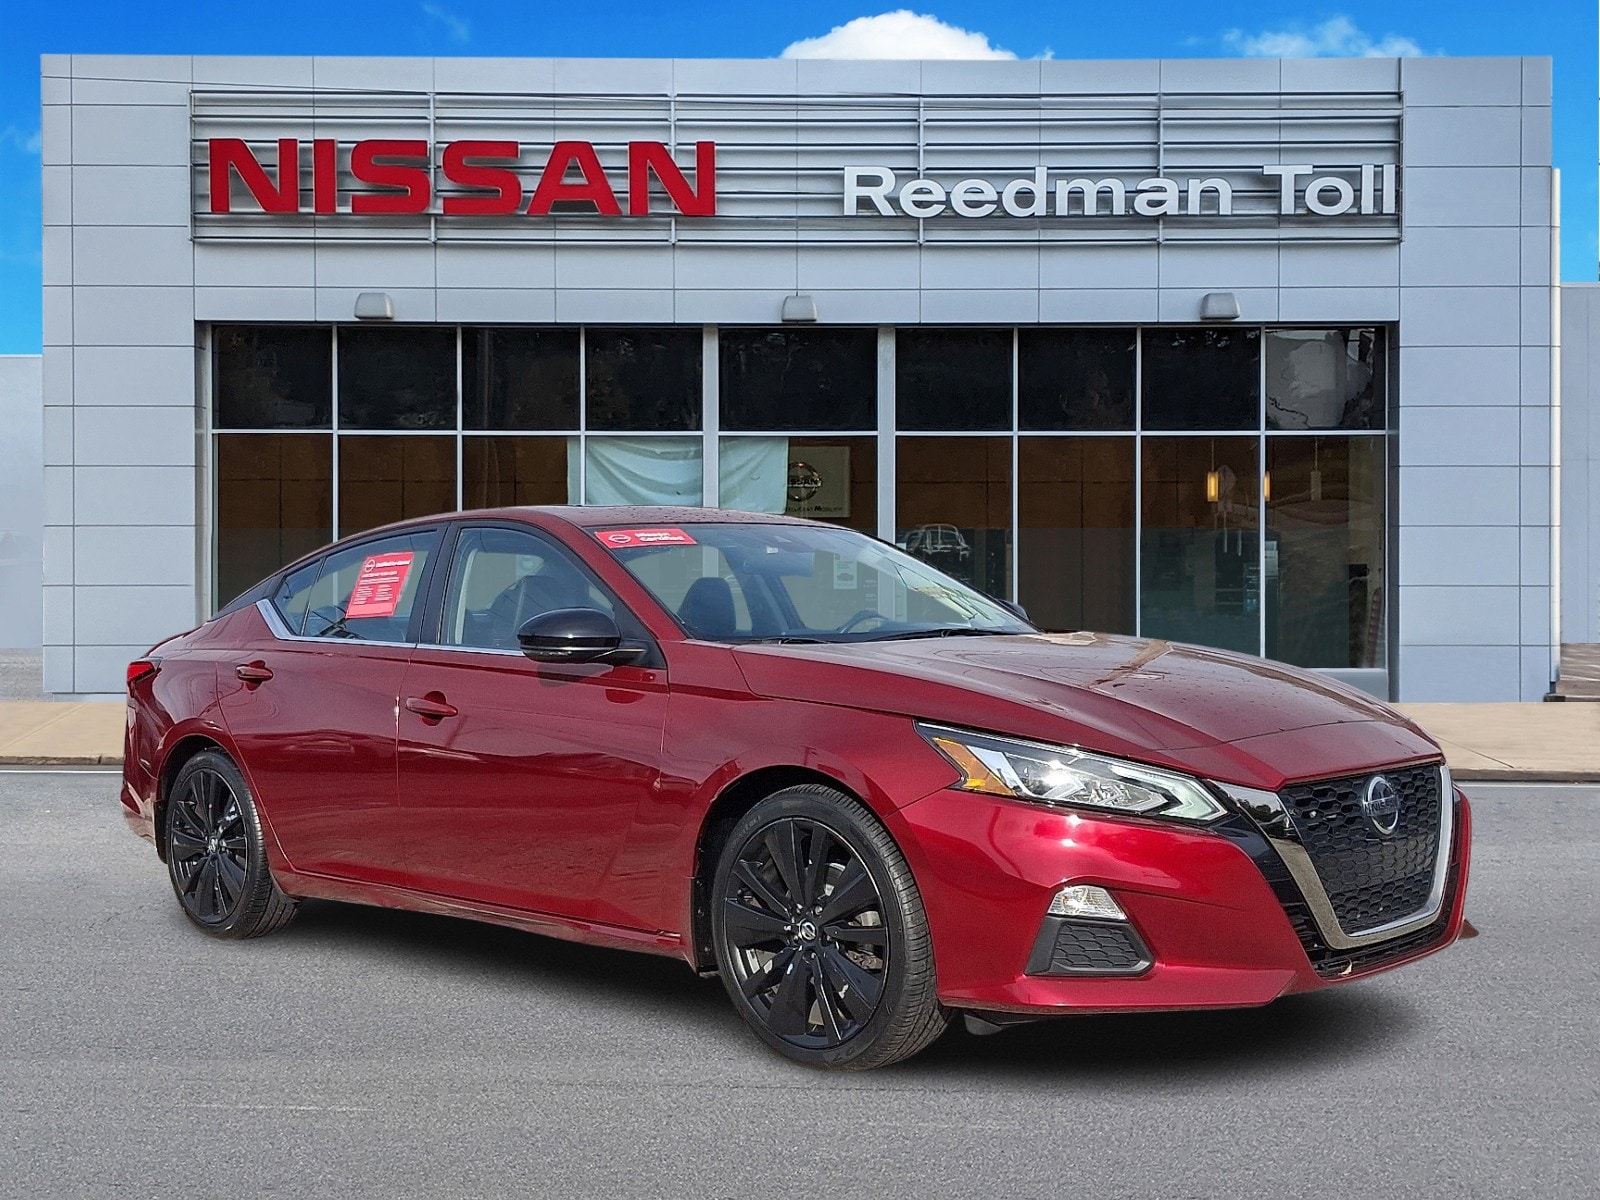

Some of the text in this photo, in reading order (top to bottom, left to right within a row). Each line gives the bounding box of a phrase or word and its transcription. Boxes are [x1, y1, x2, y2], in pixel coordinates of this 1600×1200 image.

[209, 138, 716, 217] NISSAN
[842, 164, 1396, 218] Reedman Toll
